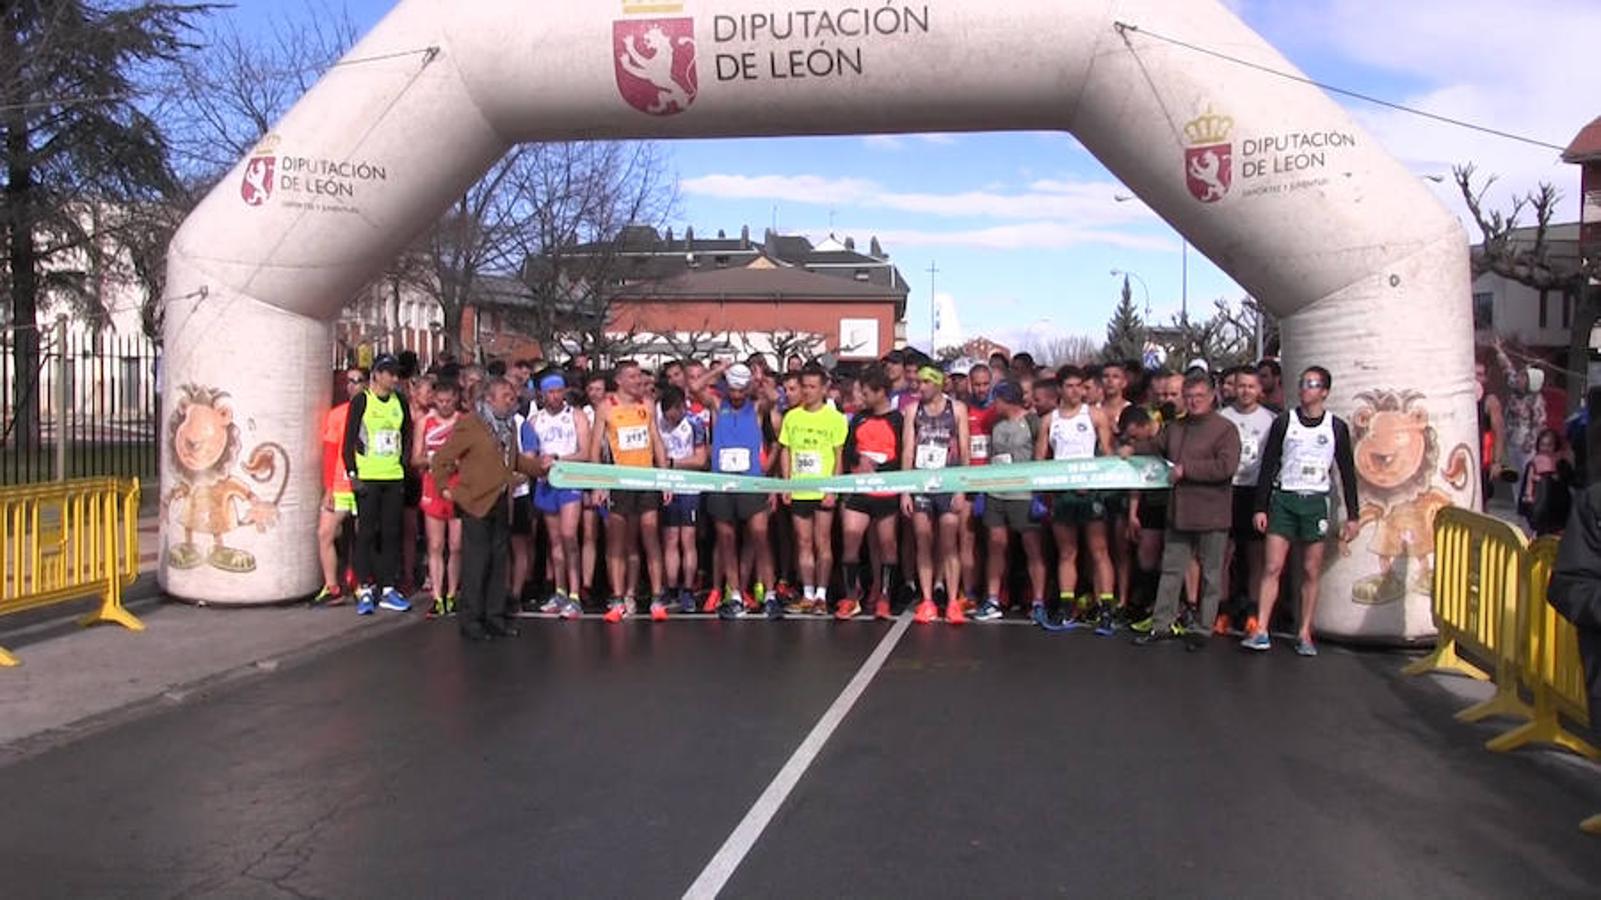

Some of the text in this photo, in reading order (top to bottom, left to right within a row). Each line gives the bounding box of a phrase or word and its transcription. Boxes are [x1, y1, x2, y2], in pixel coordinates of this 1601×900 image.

[713, 0, 929, 42] DIPUTACIÓN
[715, 40, 863, 81] DE LEÓN
[1241, 130, 1356, 157] DIPUTACIÓN
[281, 155, 387, 181] DIPUTACIÓN
[1241, 159, 1266, 178] DE
[280, 175, 301, 191] DE
